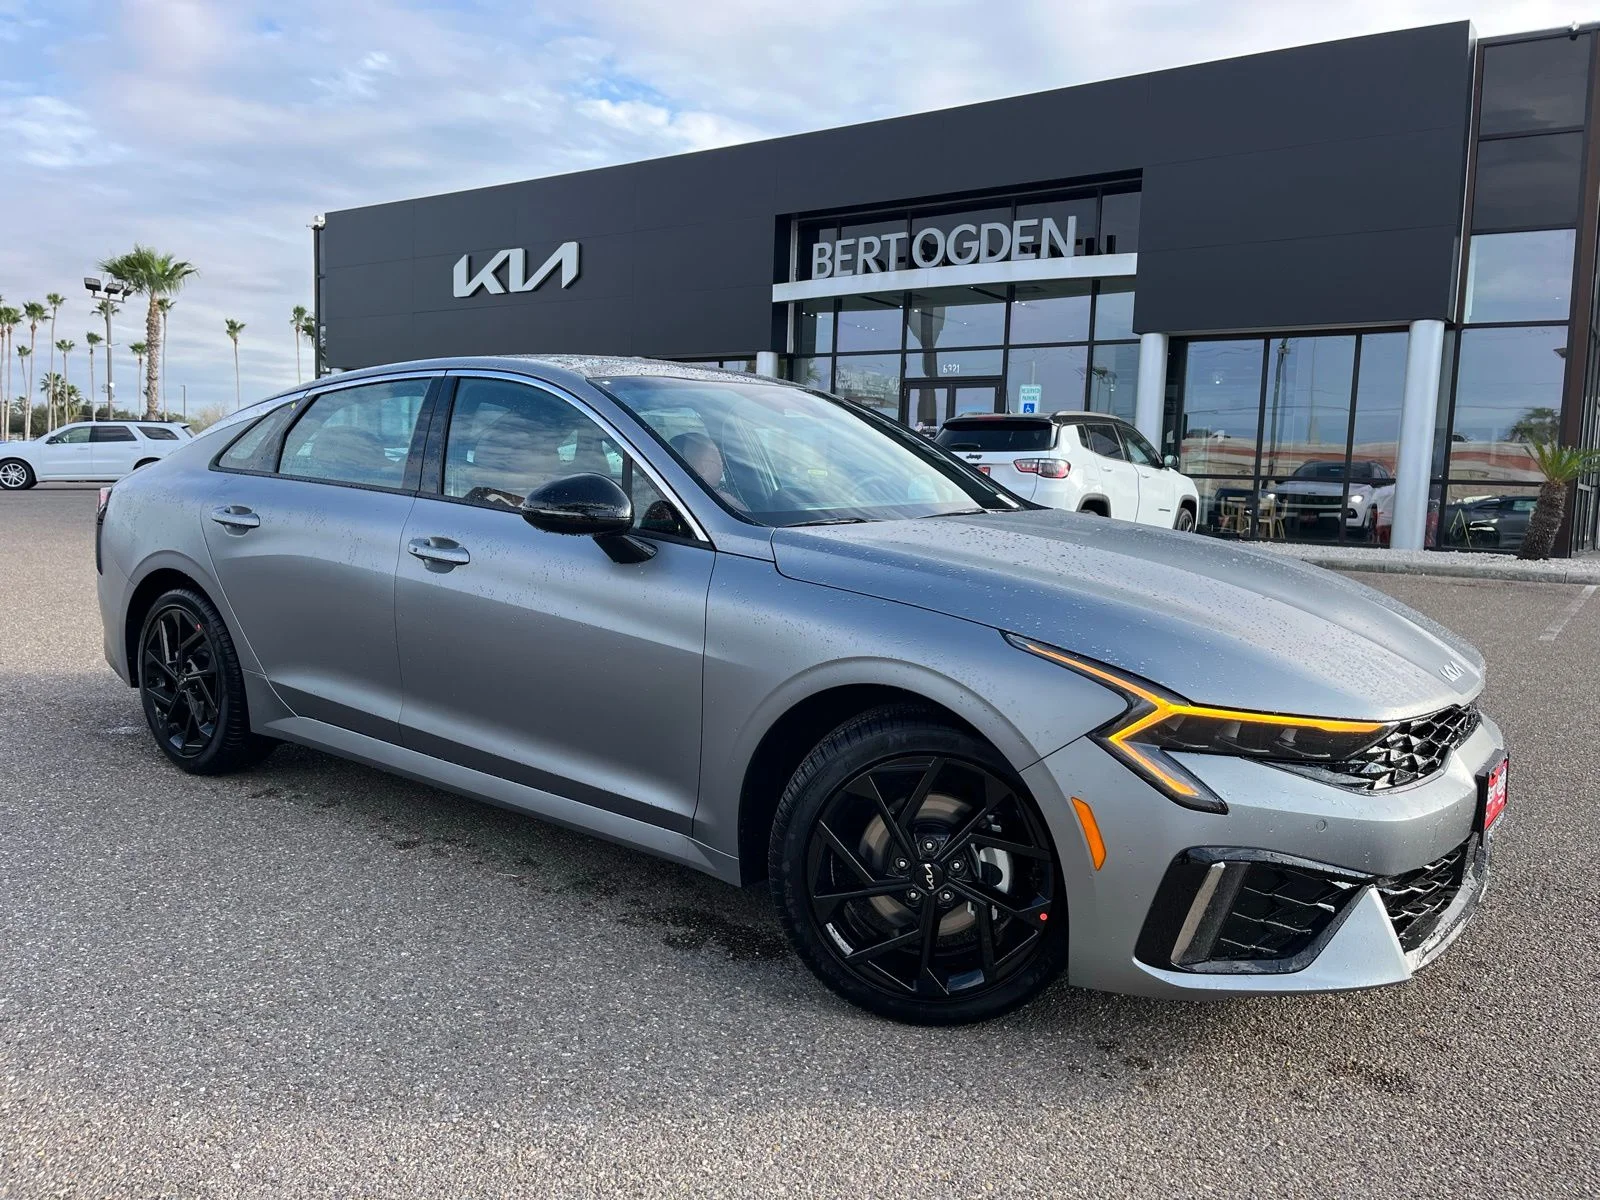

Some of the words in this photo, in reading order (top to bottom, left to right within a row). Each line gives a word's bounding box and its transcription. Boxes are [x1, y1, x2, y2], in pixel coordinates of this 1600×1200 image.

[811, 231, 908, 280] BERT
[912, 215, 1077, 269] OGDEN
[453, 241, 579, 298] KIA
[1439, 660, 1465, 682] KIA
[924, 863, 935, 890] KIA
